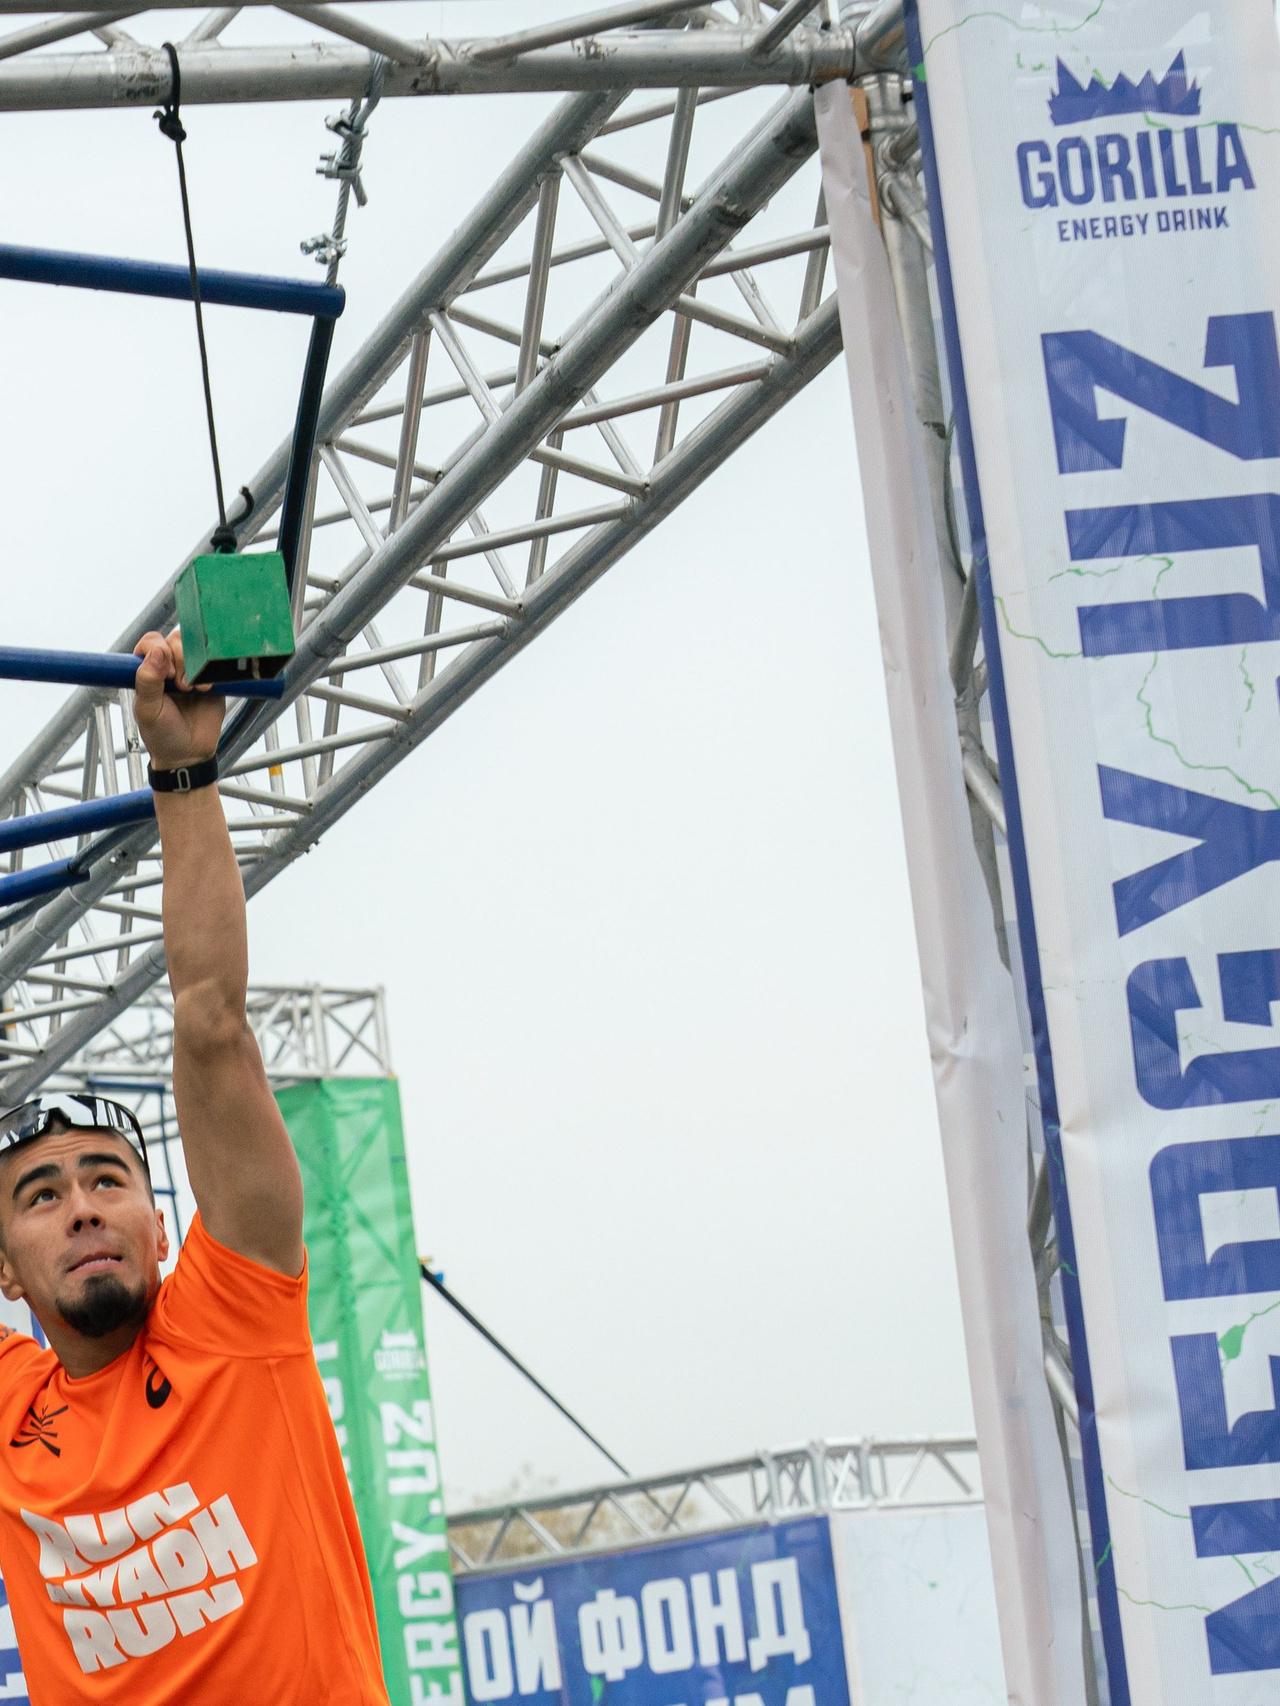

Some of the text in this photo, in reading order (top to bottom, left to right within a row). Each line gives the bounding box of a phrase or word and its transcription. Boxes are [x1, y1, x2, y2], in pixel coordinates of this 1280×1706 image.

[1017, 123, 1256, 209] GORILLA
[1057, 206, 1230, 242] ENERGY DRINK
[20, 1481, 200, 1579] RUN
[45, 1493, 258, 1607] RIYADH
[63, 1579, 244, 1674] RUN
[577, 1557, 812, 1683] ФОНД
